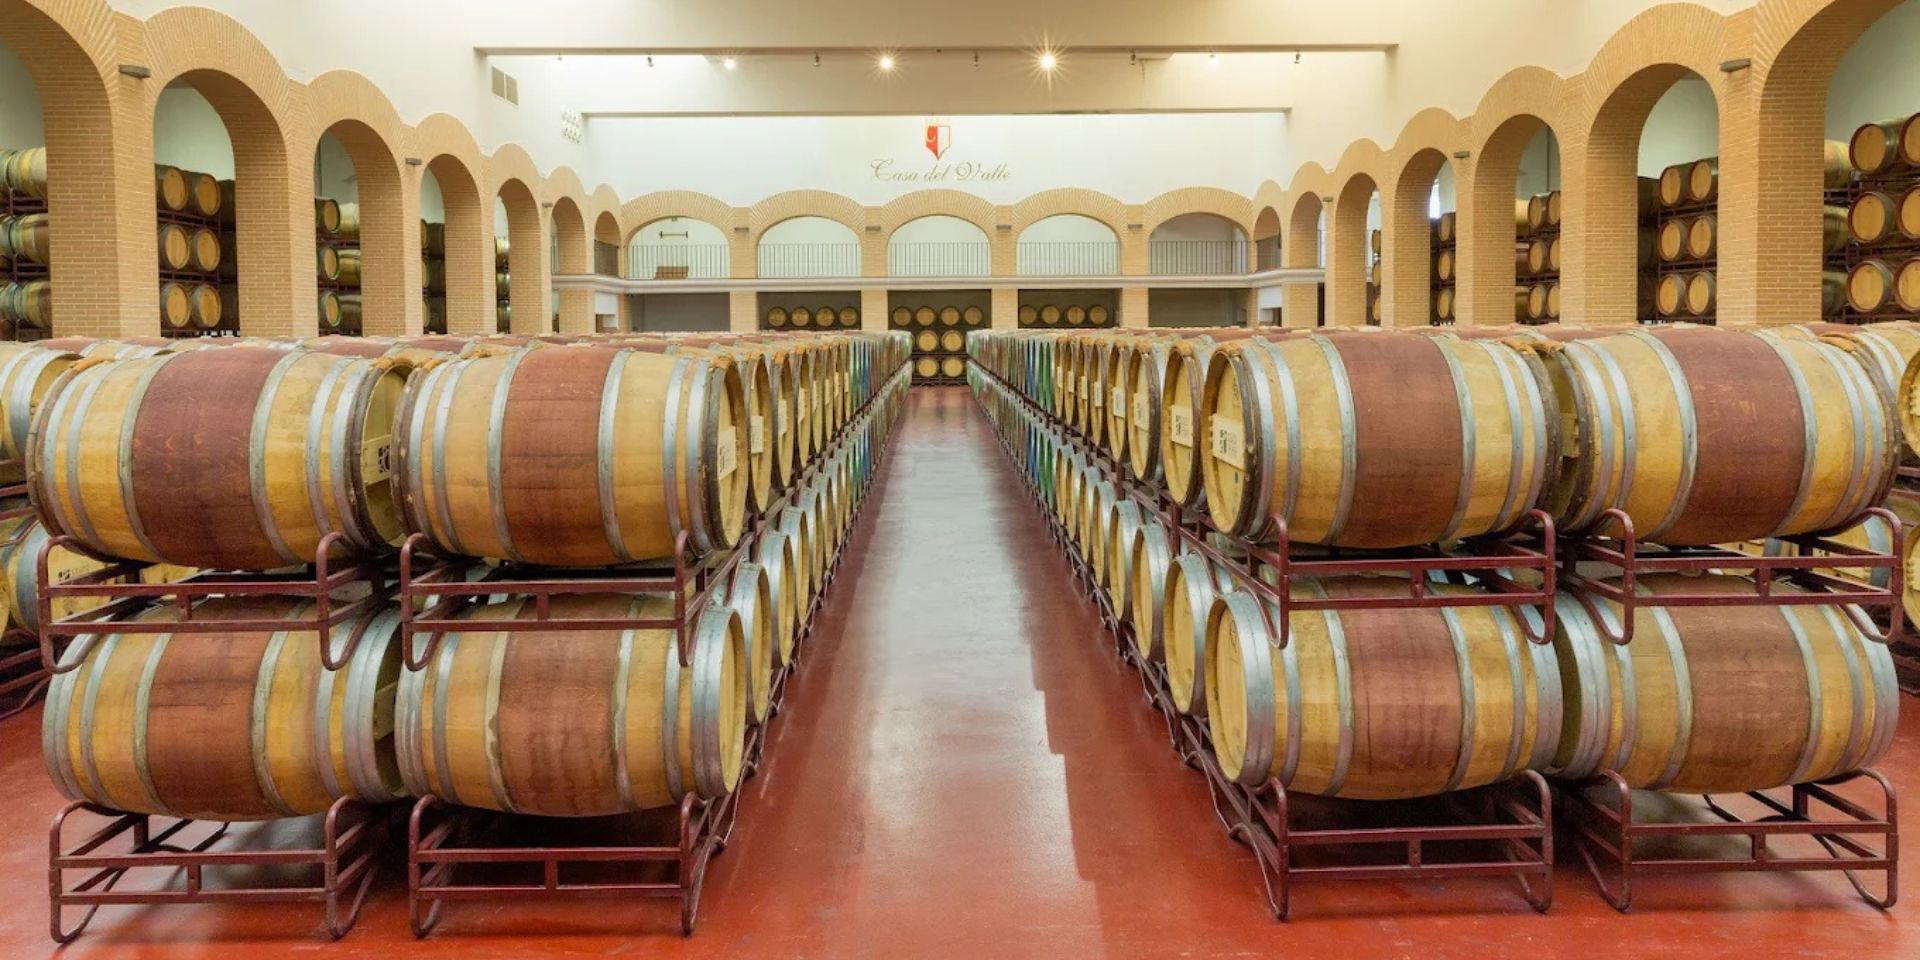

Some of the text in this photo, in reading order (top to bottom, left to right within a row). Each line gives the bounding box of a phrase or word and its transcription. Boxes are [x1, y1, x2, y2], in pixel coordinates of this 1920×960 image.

[870, 158, 1011, 183] Casa del Valle
